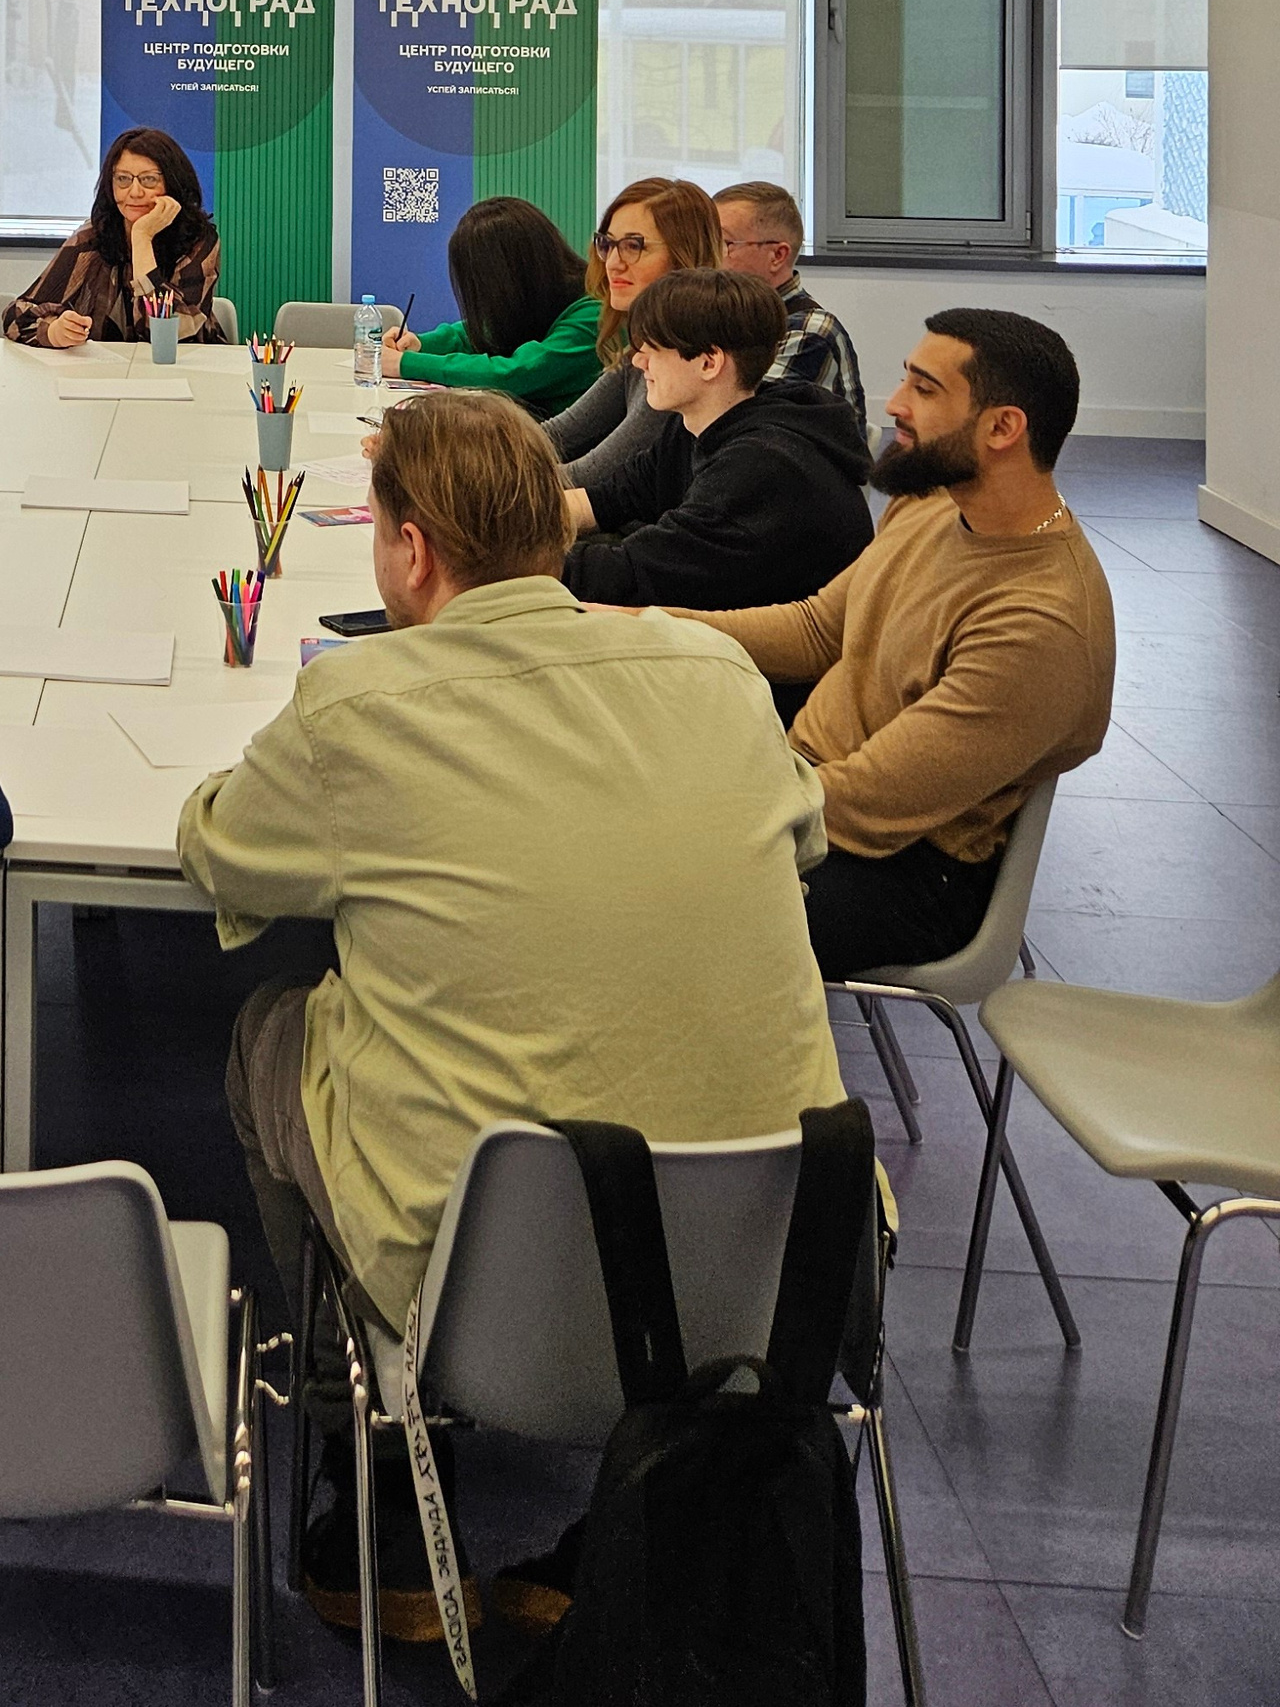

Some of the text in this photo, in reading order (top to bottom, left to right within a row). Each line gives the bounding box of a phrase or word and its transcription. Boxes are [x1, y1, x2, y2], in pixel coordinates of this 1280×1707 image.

[144, 42, 289, 57] ЦЕНТР ПОДГОТОВКИ
[399, 44, 551, 59] ЦЕНТР ПОДГОТОВКИ
[177, 58, 255, 72] БУДУЩЕГО
[434, 60, 515, 75] БУДУЩЕГО
[170, 82, 259, 92] УСПЕЙ ЗАПИСАТЬСЯ!
[426, 84, 519, 95] УСПЕЙ ЗАПИСАТЬСЯ!
